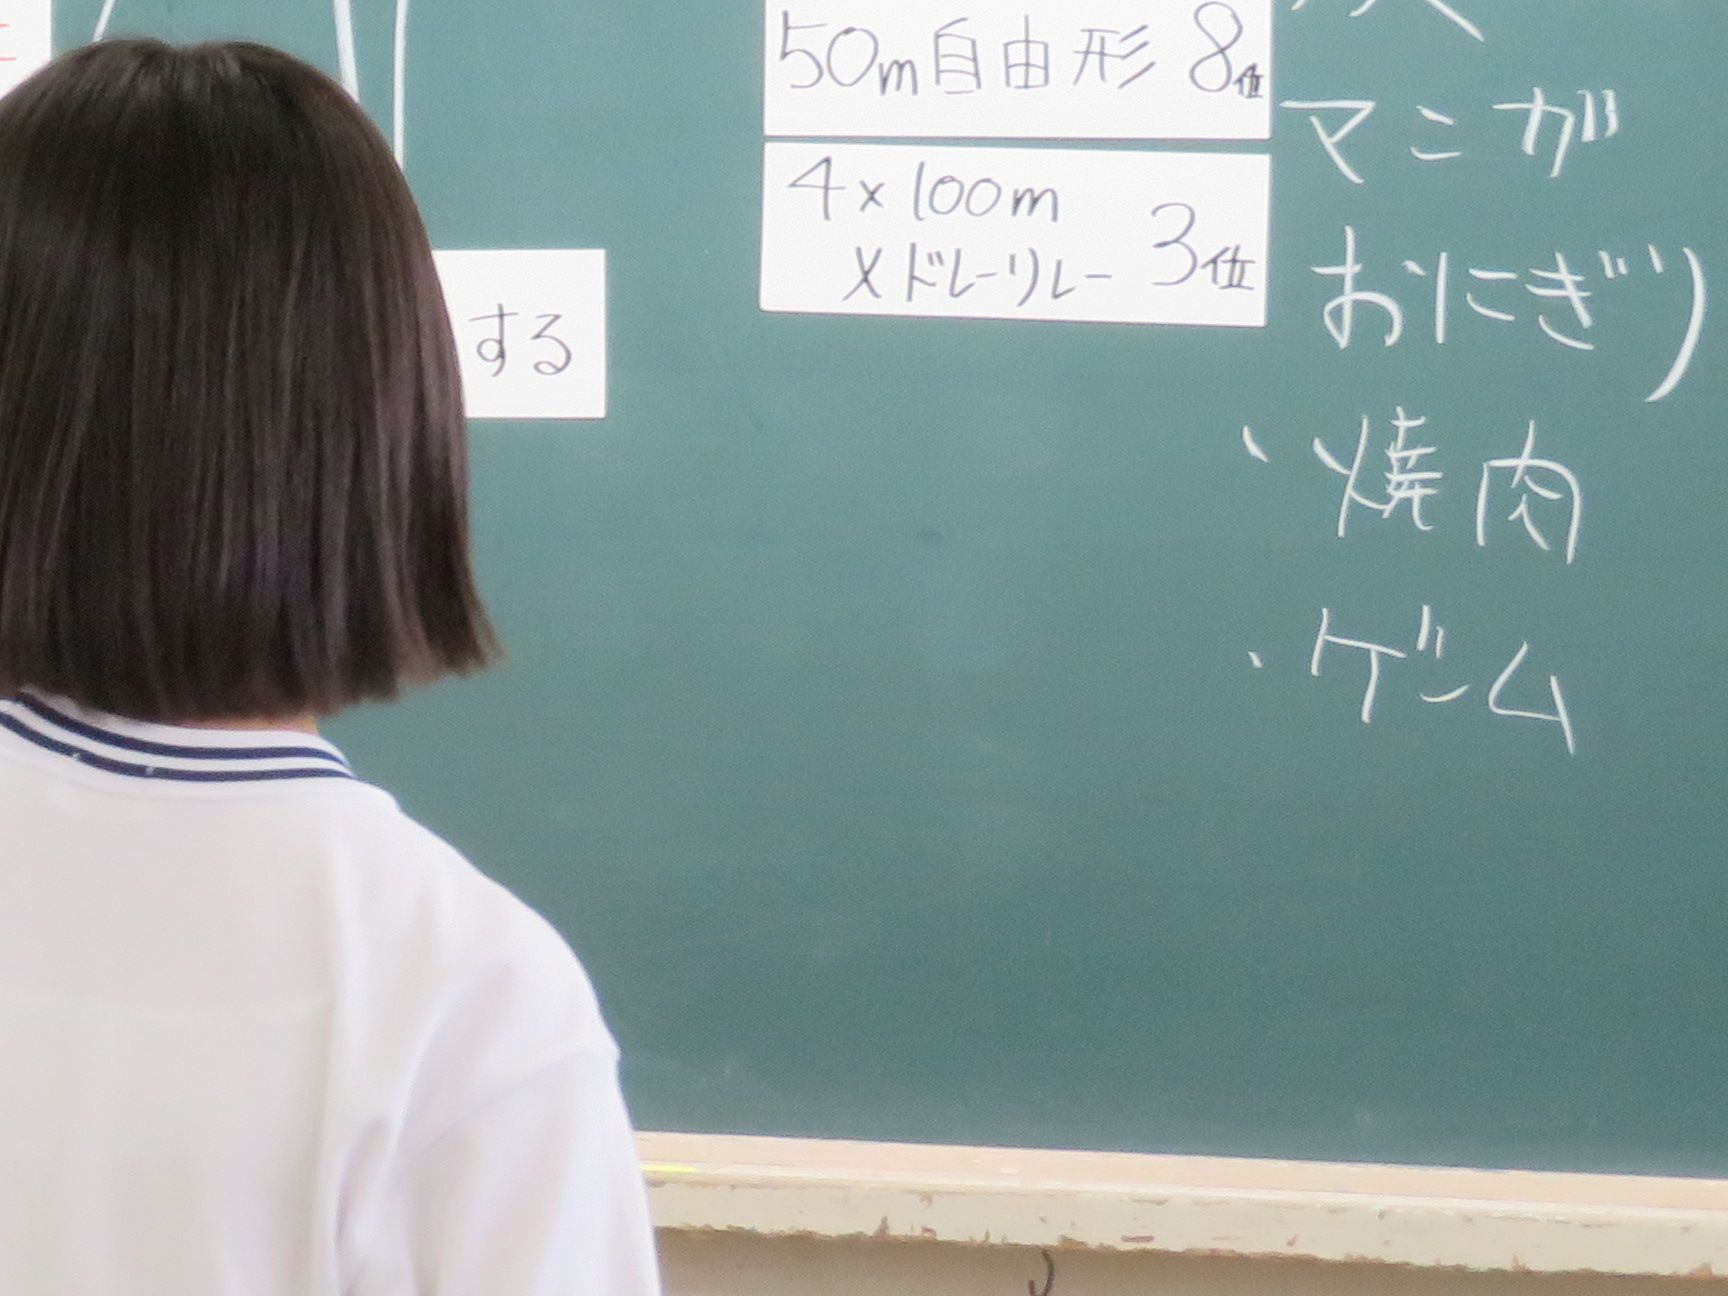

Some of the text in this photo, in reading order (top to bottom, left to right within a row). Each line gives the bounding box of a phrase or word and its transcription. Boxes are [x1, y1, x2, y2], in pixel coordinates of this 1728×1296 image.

[841, 242, 1113, 308] メドレーリレー
[1149, 201, 1256, 291] 3位
[1311, 226, 1706, 404] おにぎり
